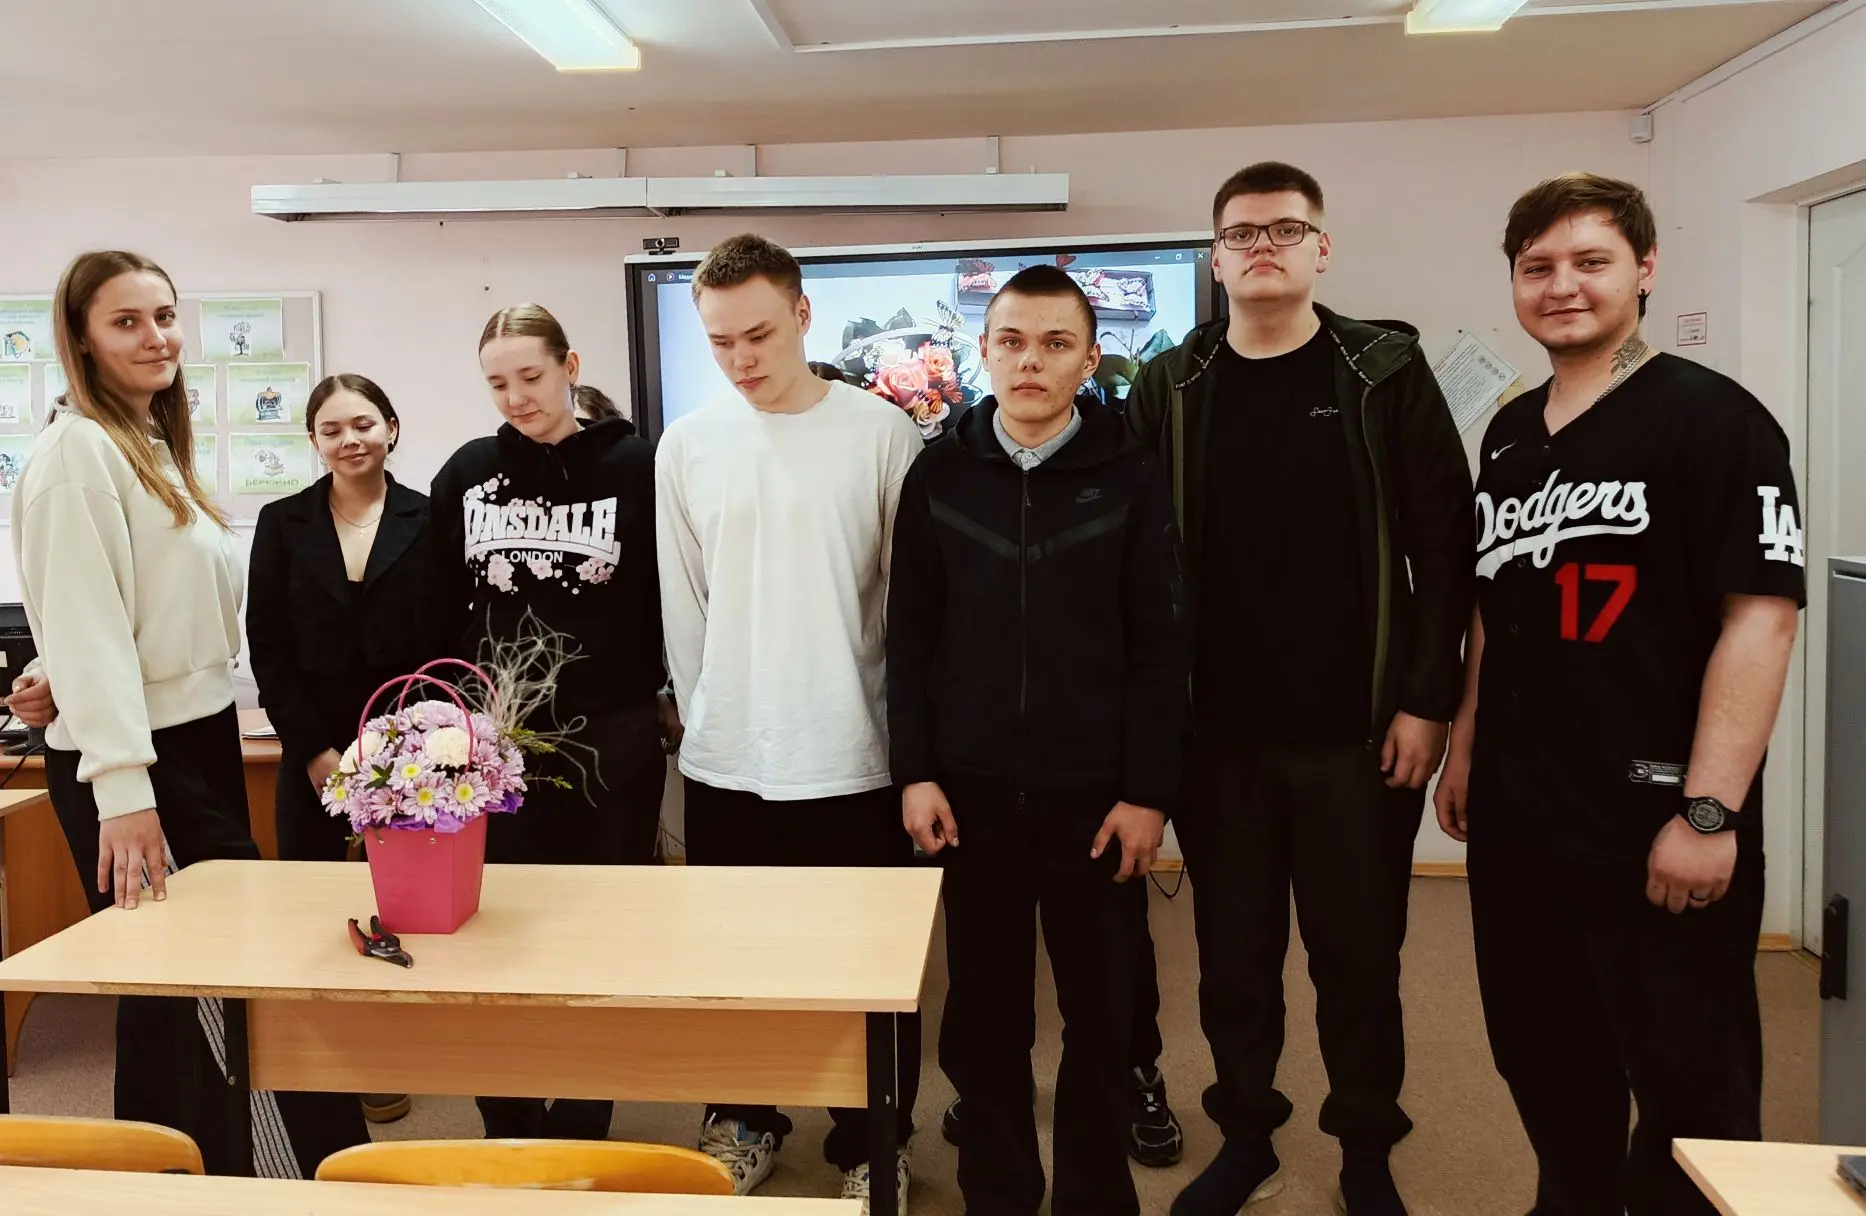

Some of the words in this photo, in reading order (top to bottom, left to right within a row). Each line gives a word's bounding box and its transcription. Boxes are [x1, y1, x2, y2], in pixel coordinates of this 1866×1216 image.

[501, 550, 563, 563] LONDON
[1475, 469, 1650, 569] Dodgers
[1757, 485, 1804, 567] LA
[1555, 562, 1637, 642] 17
